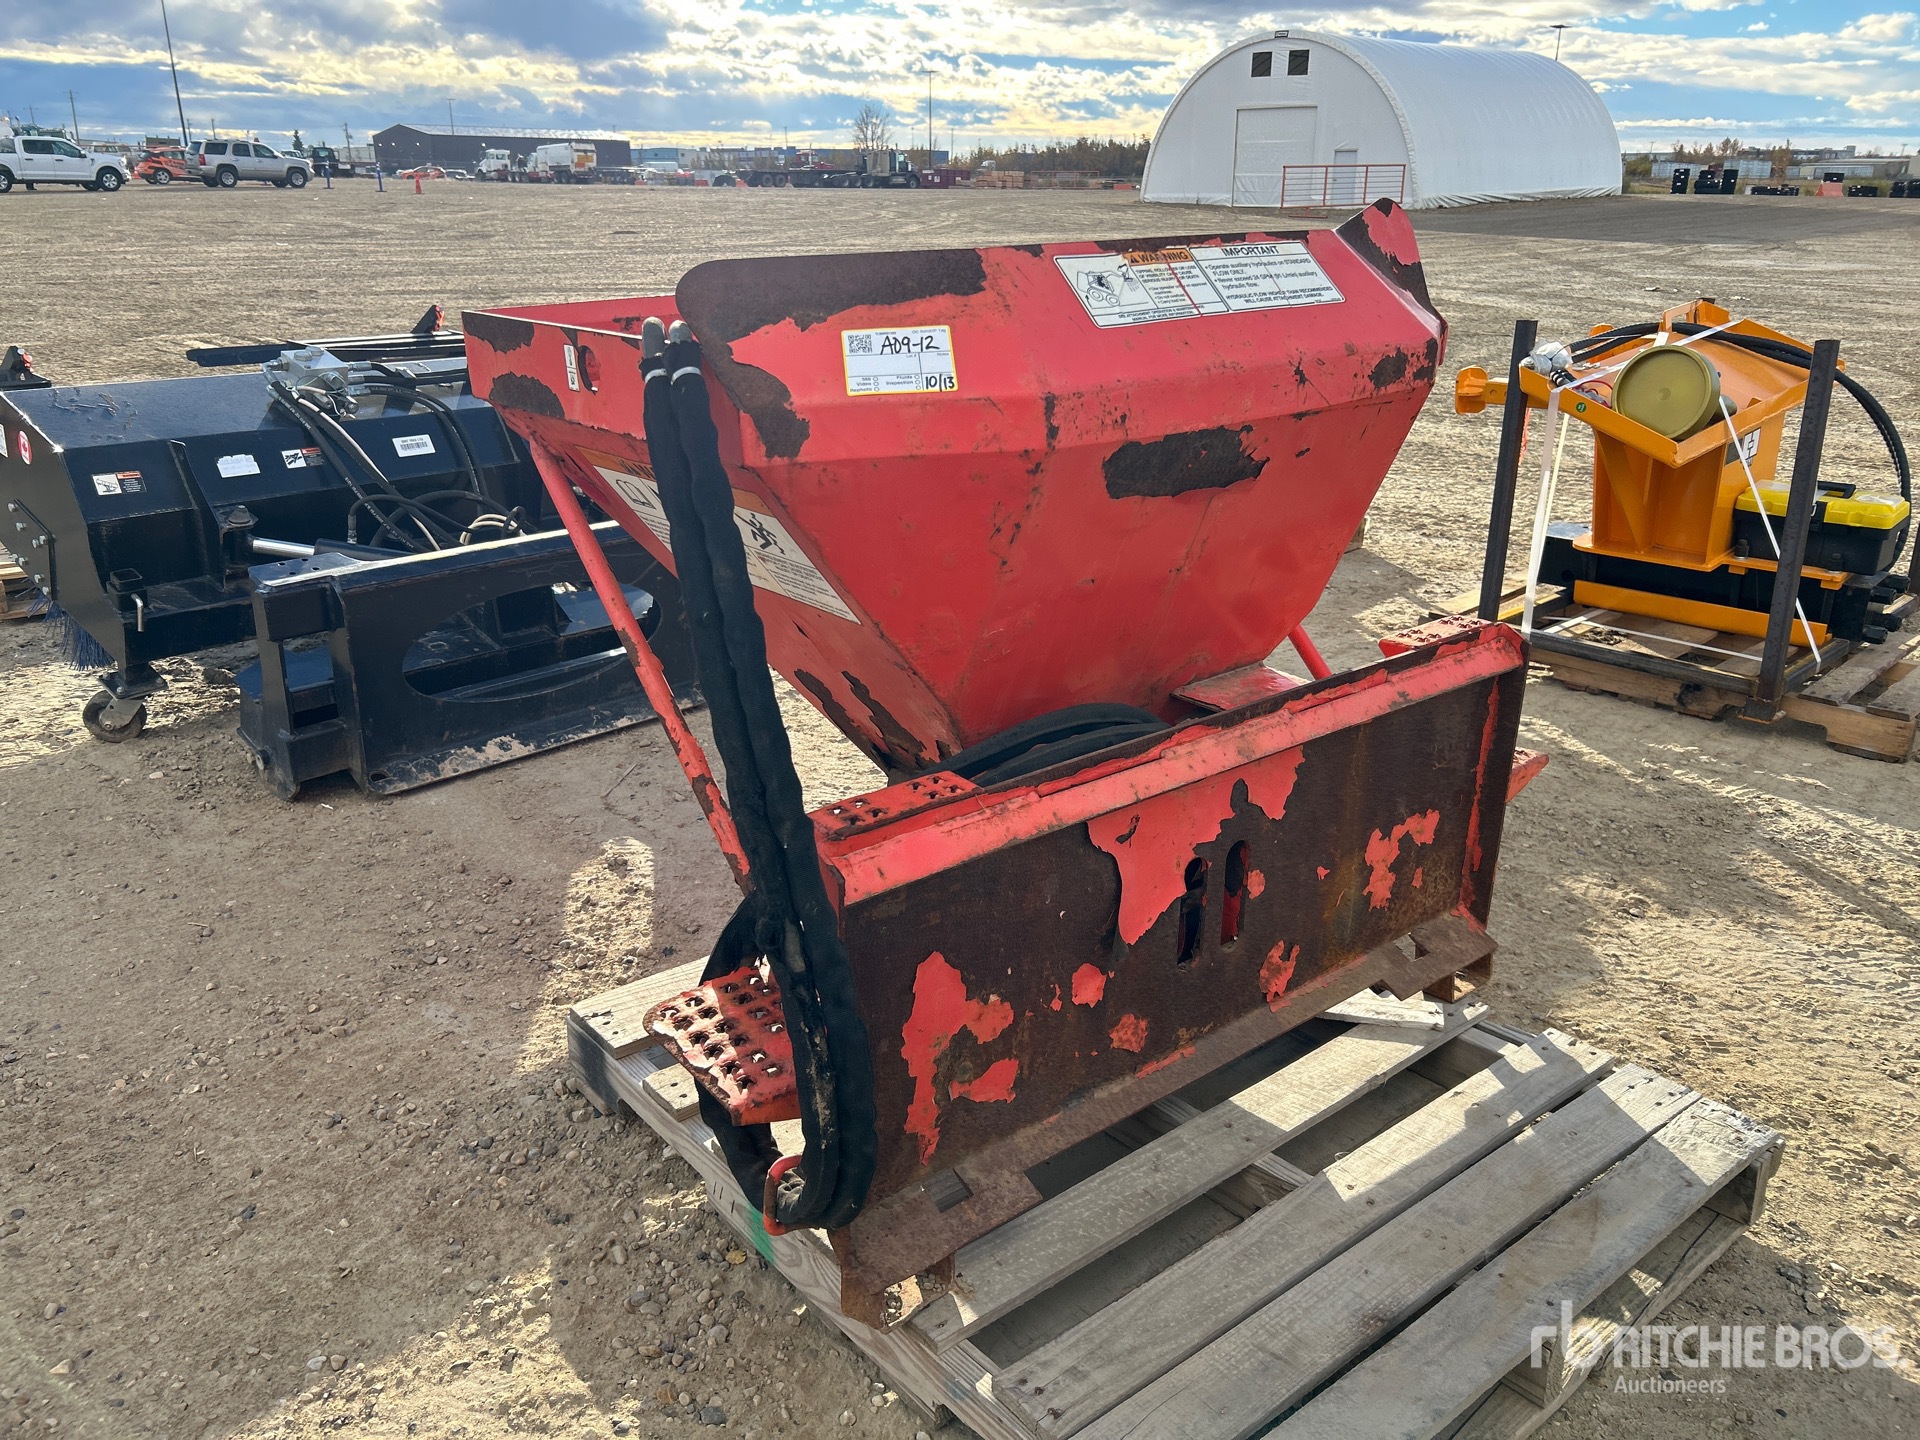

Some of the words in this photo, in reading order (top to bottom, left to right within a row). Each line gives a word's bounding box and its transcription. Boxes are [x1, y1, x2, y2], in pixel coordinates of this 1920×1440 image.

[1138, 251, 1188, 263] WARNING
[1221, 246, 1280, 256] IMPORTANT
[925, 374, 955, 392] 10/13
